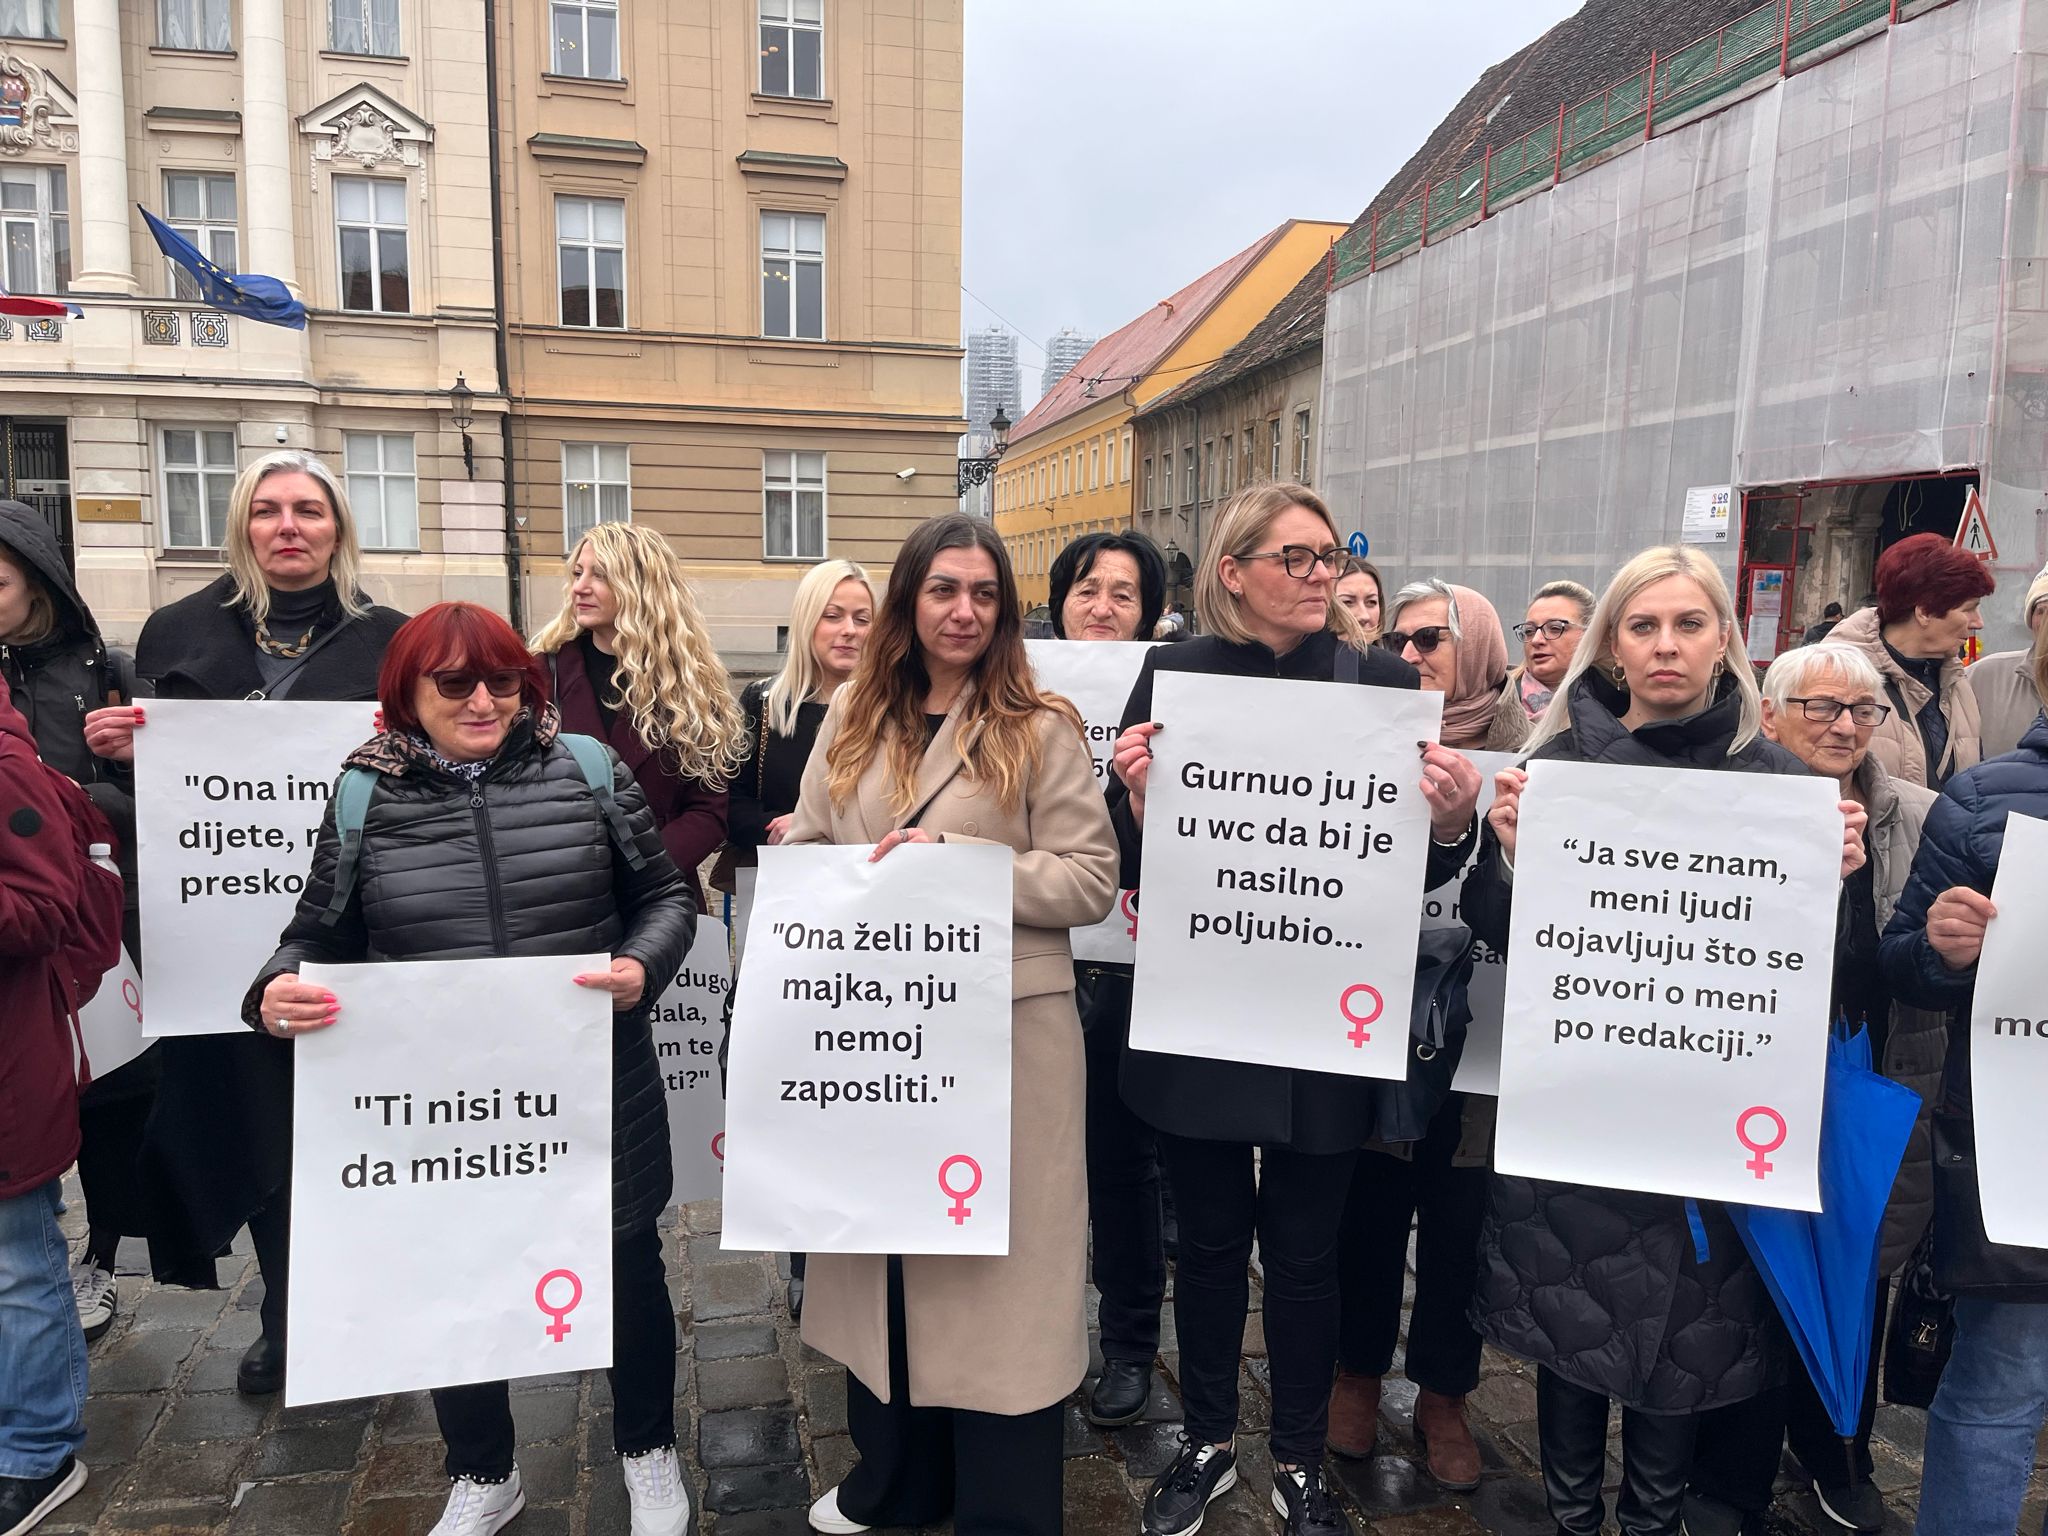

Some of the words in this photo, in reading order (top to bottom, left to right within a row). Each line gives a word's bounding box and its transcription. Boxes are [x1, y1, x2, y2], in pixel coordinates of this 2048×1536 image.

[185, 775, 277, 801] "Ona
[287, 774, 330, 801] im
[1181, 761, 1313, 797] Gurnuo
[1319, 770, 1355, 807] ju
[1361, 773, 1398, 810] je
[179, 821, 295, 856] dijete,
[1177, 816, 1197, 838] u
[1208, 818, 1256, 842] wc
[1265, 817, 1308, 847] da
[1319, 820, 1352, 850] bi
[1357, 823, 1393, 860] je
[1563, 838, 1615, 866] “Ja
[1623, 849, 1679, 871] sve
[1687, 853, 1787, 886] znam,
[181, 868, 304, 904] presko
[1216, 866, 1344, 903] nasilno
[1590, 889, 1670, 915] meni
[1680, 890, 1752, 924] ljudi
[773, 922, 845, 951] "Ona
[853, 922, 912, 952] želi
[924, 923, 980, 953] biti
[1189, 910, 1363, 951] poljubio...
[1535, 923, 1694, 966] dojavljuju
[1704, 937, 1757, 967] što
[1766, 950, 1804, 971] se
[783, 972, 893, 1010] majka,
[904, 973, 957, 1011] nju
[1552, 974, 1655, 1003] govori
[1665, 986, 1684, 1005] o
[1695, 988, 1777, 1015] meni
[688, 1038, 714, 1055] te
[815, 1023, 922, 1060] nemoj
[1554, 1019, 1594, 1044] po
[1604, 1022, 1772, 1062] redakciji.”
[664, 1070, 710, 1092] ti?"
[780, 1073, 955, 1110] zaposliti."
[354, 1093, 412, 1126] "Ti
[428, 1088, 501, 1125] nisi
[514, 1090, 557, 1119] tu
[341, 1153, 397, 1189] da
[411, 1141, 568, 1184] misliš!"
